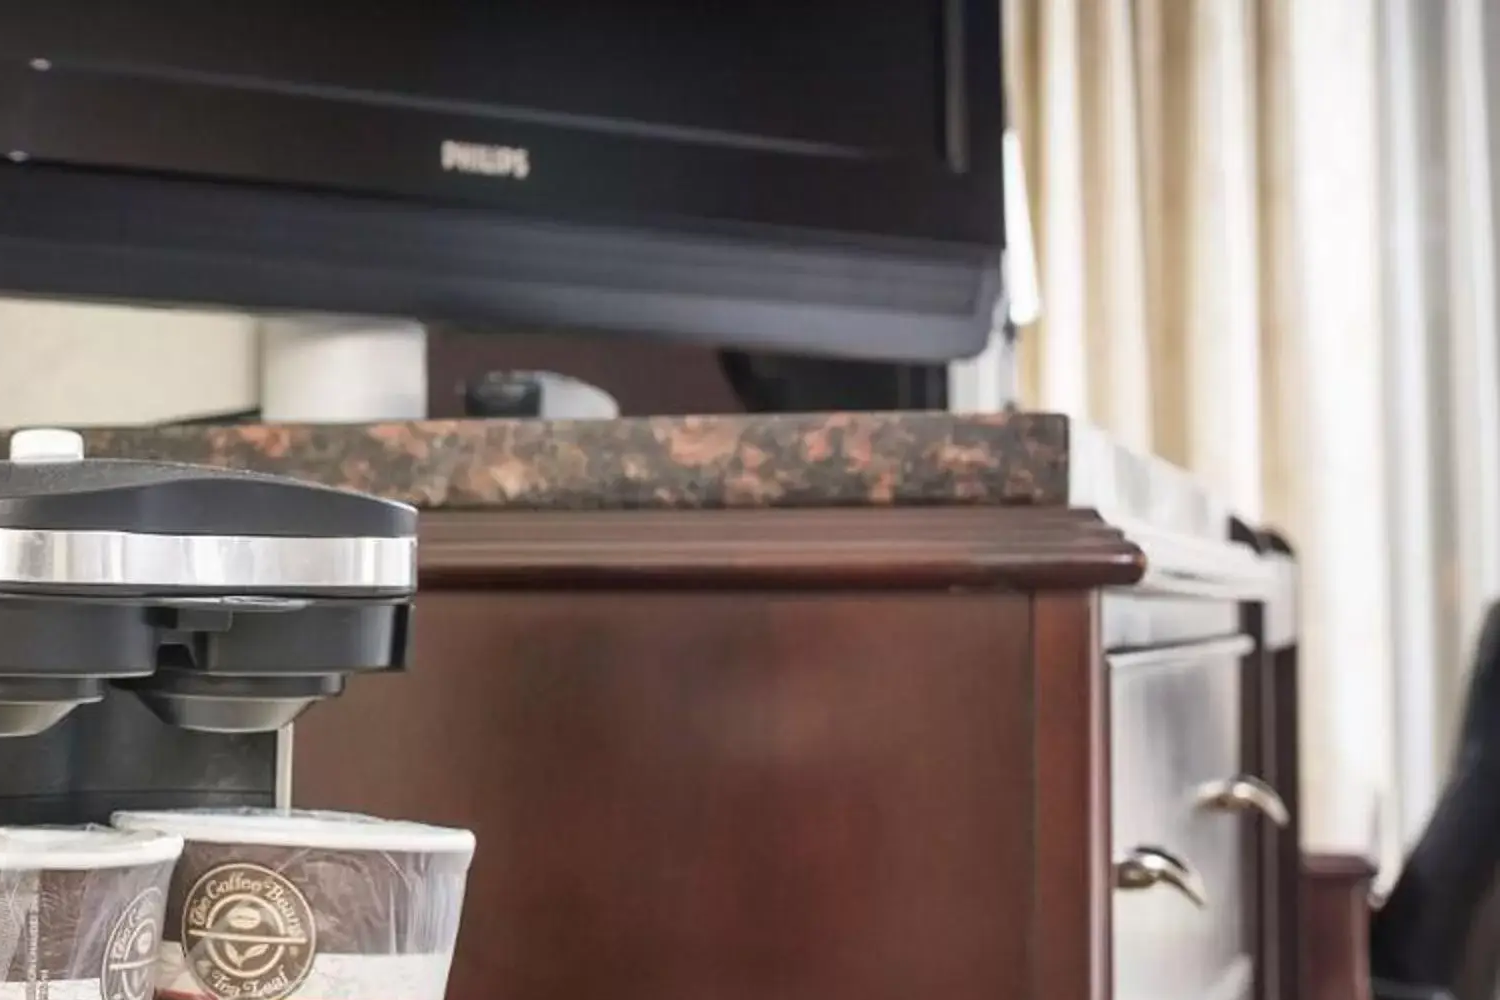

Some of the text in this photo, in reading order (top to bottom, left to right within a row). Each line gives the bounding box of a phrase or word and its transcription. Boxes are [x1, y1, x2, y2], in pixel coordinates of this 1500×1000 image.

[440, 139, 531, 180] PHILIPS
[206, 871, 263, 899] Coffee
[212, 964, 289, 998] Tea Leaf
